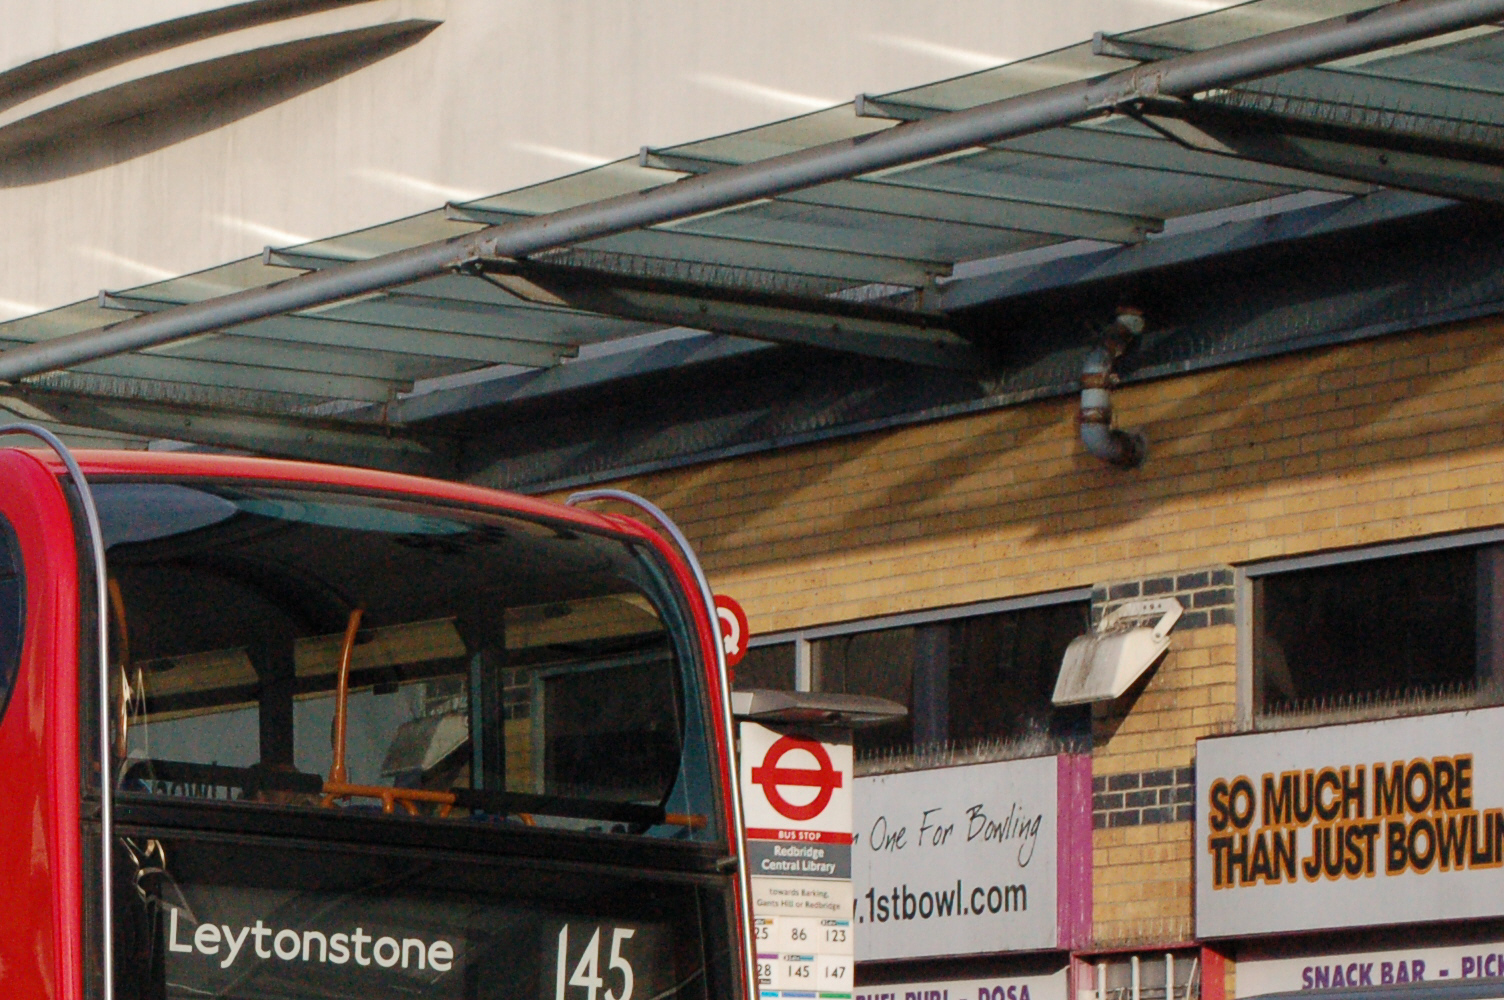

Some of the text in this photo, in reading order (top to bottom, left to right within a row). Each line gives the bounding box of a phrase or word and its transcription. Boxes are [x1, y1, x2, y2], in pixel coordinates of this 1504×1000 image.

[1208, 752, 1473, 832] SO MUCH MORE
[778, 830, 821, 840] BUS STOP
[870, 816, 907, 852] One
[918, 808, 954, 847] For
[966, 802, 1042, 868] Bowling
[774, 845, 825, 860] Redbridge
[1208, 827, 1297, 888] THAN
[1301, 818, 1381, 883] JUST
[761, 858, 836, 875] Central Library
[769, 888, 800, 897] towards
[757, 899, 779, 907] Gants
[781, 899, 794, 908] Hill
[805, 902, 841, 911] Redbridge
[168, 907, 454, 971] Leytonstone
[791, 928, 807, 940] 86
[826, 930, 846, 942] 123
[788, 965, 810, 978] 145
[825, 966, 846, 979] 147
[1302, 963, 1374, 990] SNACK
[1381, 959, 1426, 986] BAR
